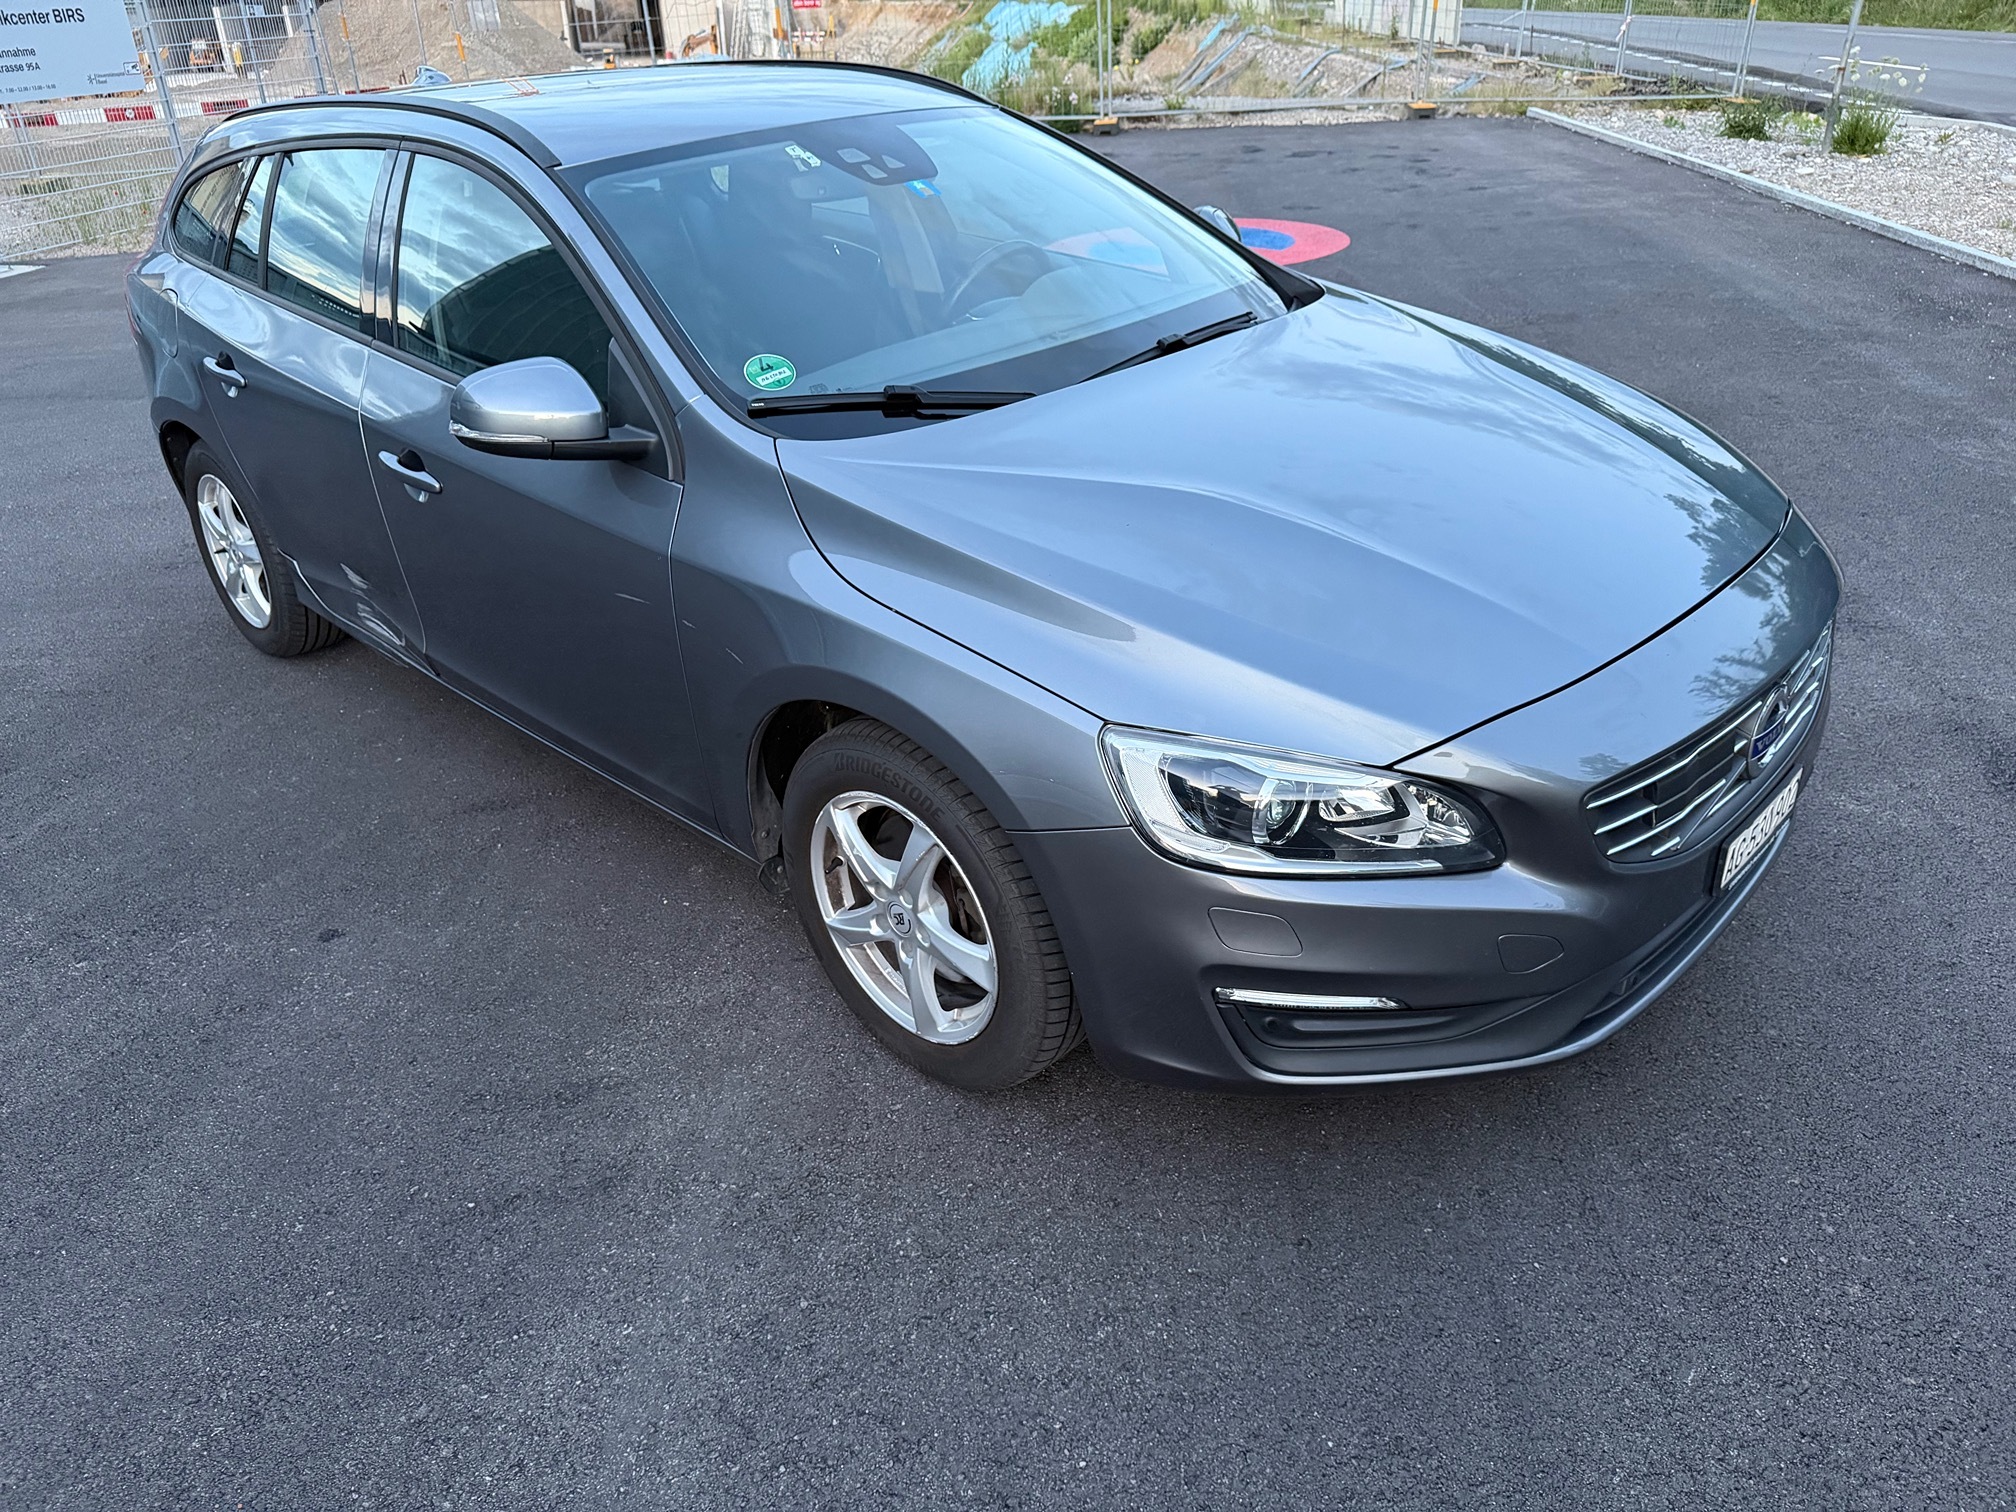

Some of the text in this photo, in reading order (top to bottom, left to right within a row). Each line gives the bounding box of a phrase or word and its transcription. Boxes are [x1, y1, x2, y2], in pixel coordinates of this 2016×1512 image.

[0, 8, 85, 25] kcenter BIRS
[834, 752, 946, 821] BRIDGESTONE
